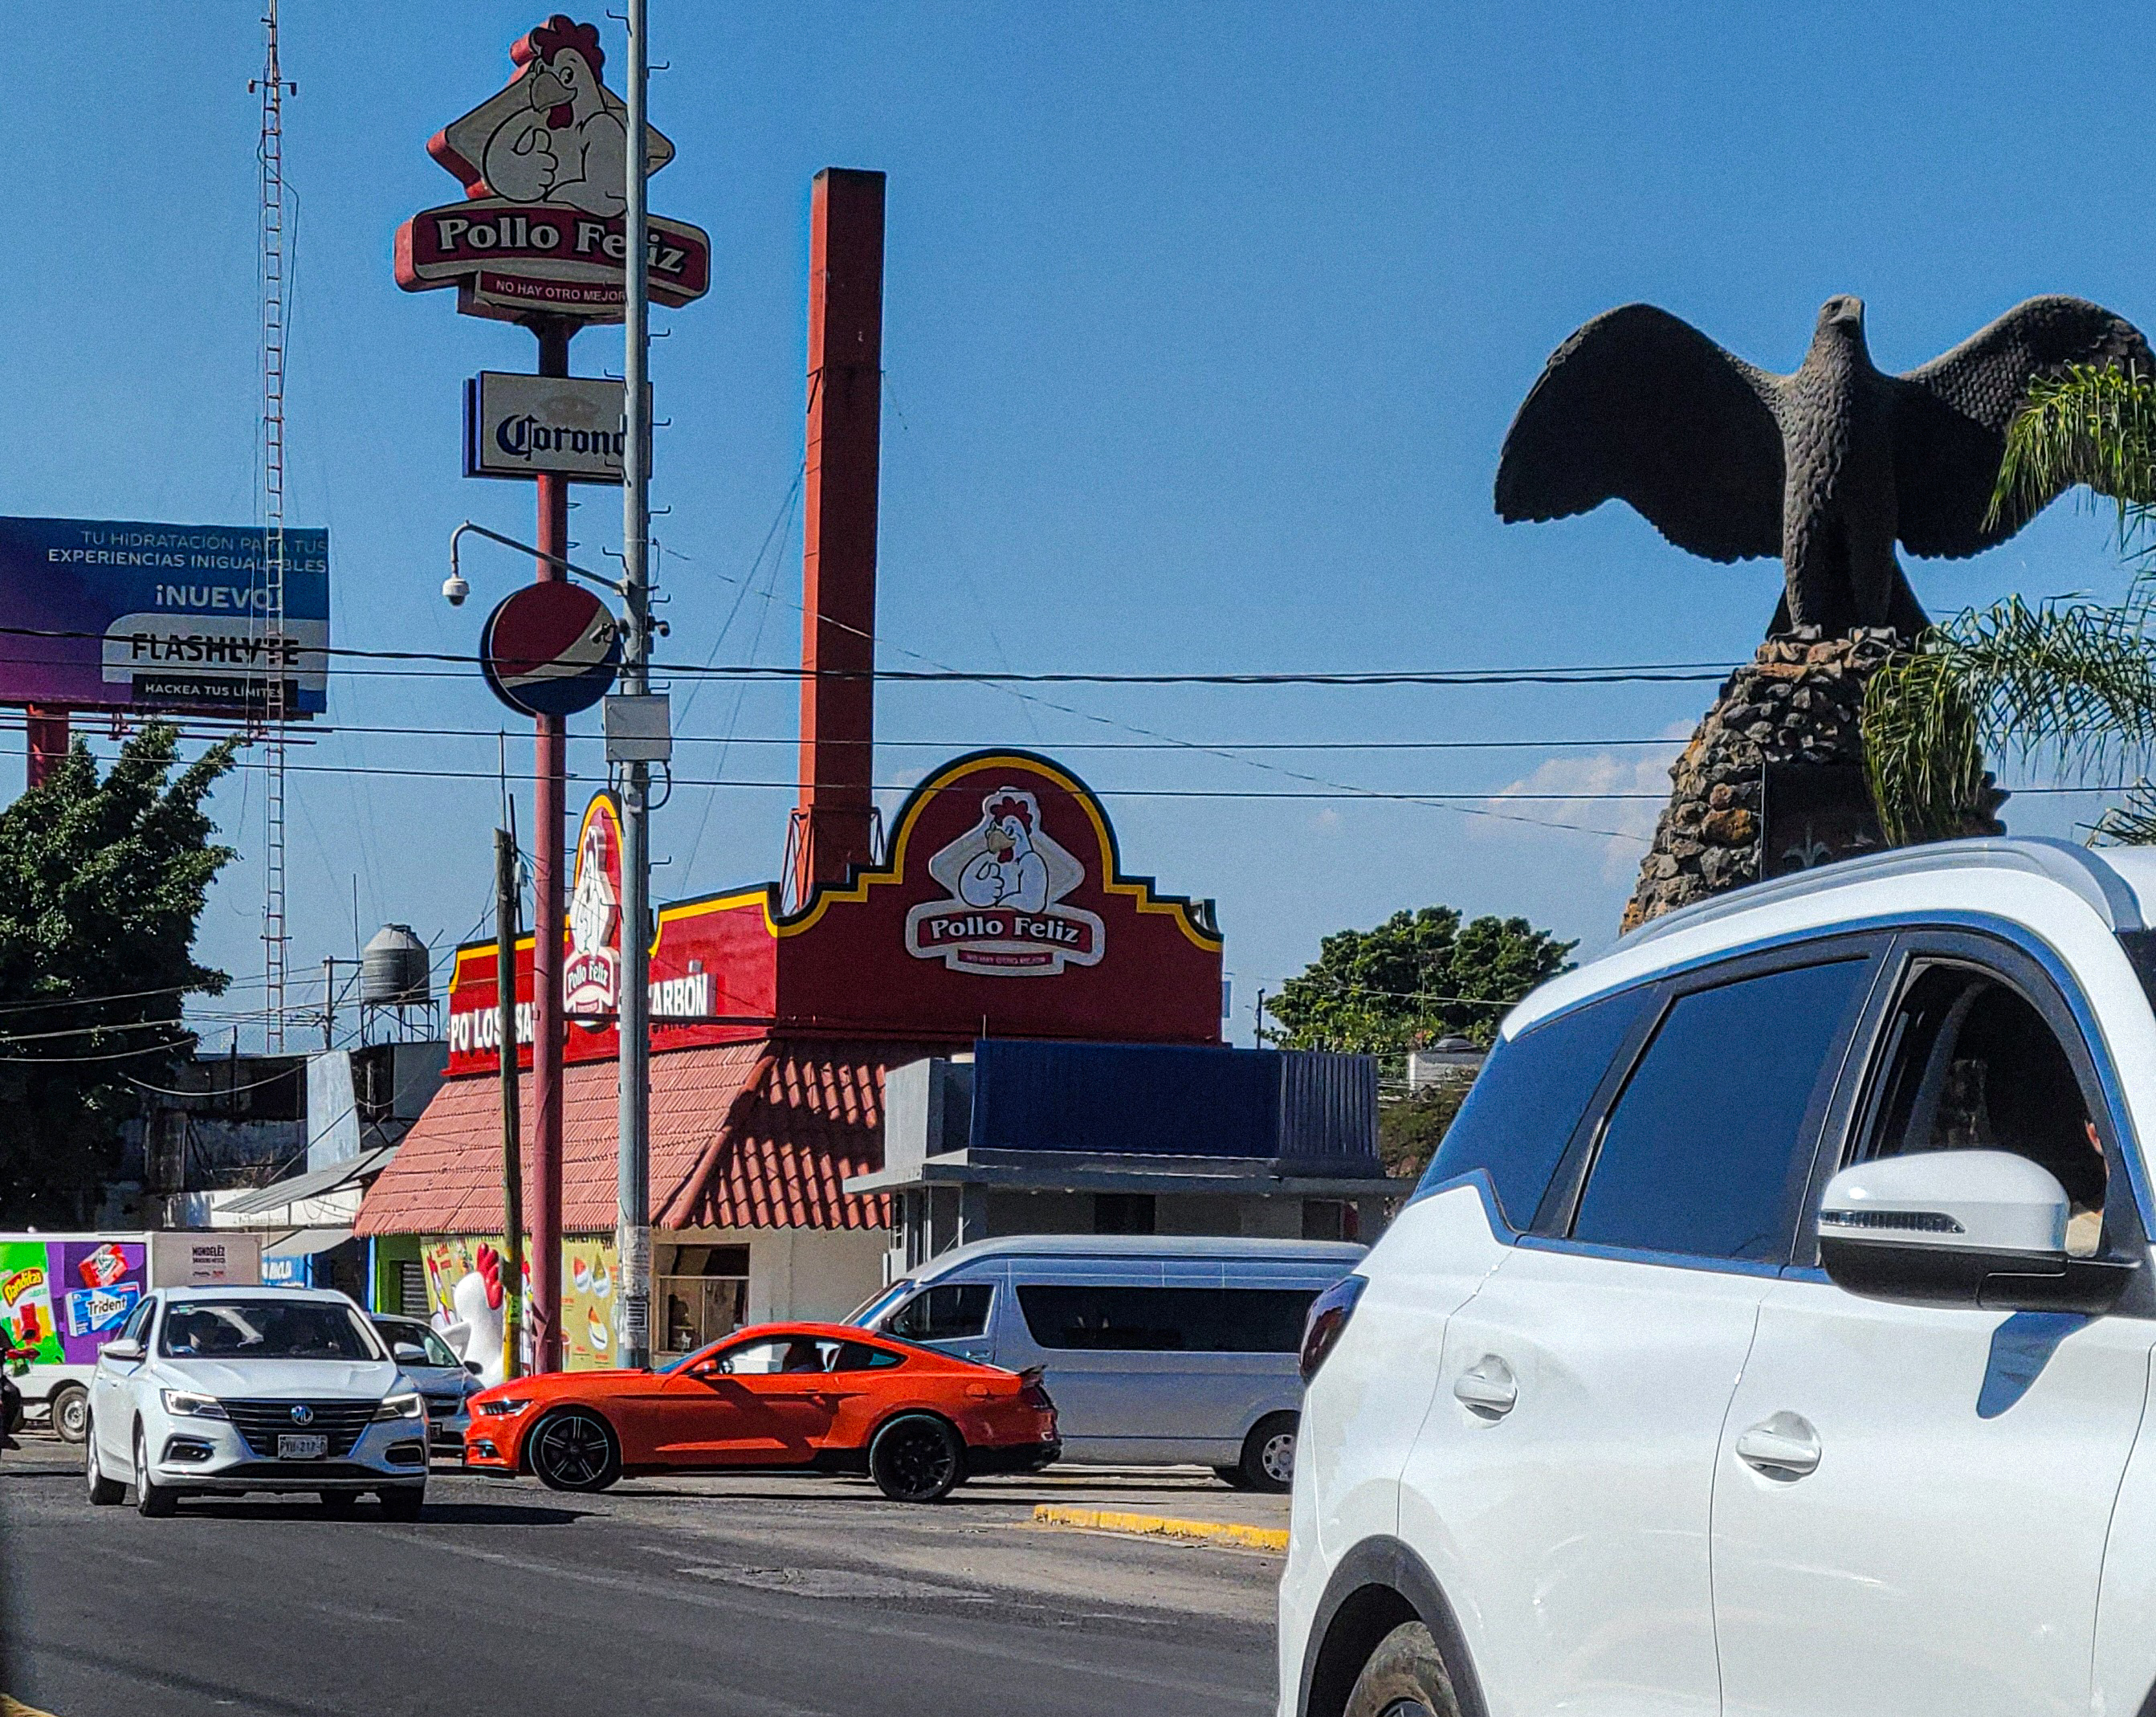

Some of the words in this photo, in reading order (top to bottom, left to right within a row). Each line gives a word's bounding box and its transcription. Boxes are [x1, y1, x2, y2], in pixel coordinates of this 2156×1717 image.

[436, 217, 560, 251] Pollo
[575, 221, 685, 274] Feiz
[495, 279, 514, 293] NO
[517, 284, 542, 297] HAY
[544, 288, 581, 300] OTRO
[81, 530, 105, 545] TU
[294, 539, 327, 554] TUS
[48, 549, 185, 568] EXPERIENCIAS
[145, 683, 201, 695] HACKEA
[204, 686, 230, 697] TUS
[931, 916, 1004, 940] Pollo
[1013, 916, 1080, 944] Feliz
[568, 964, 587, 994] Pollo
[589, 959, 609, 988] Feliz
[648, 959, 708, 1017] ARBÓN
[88, 1296, 127, 1316] Trident
